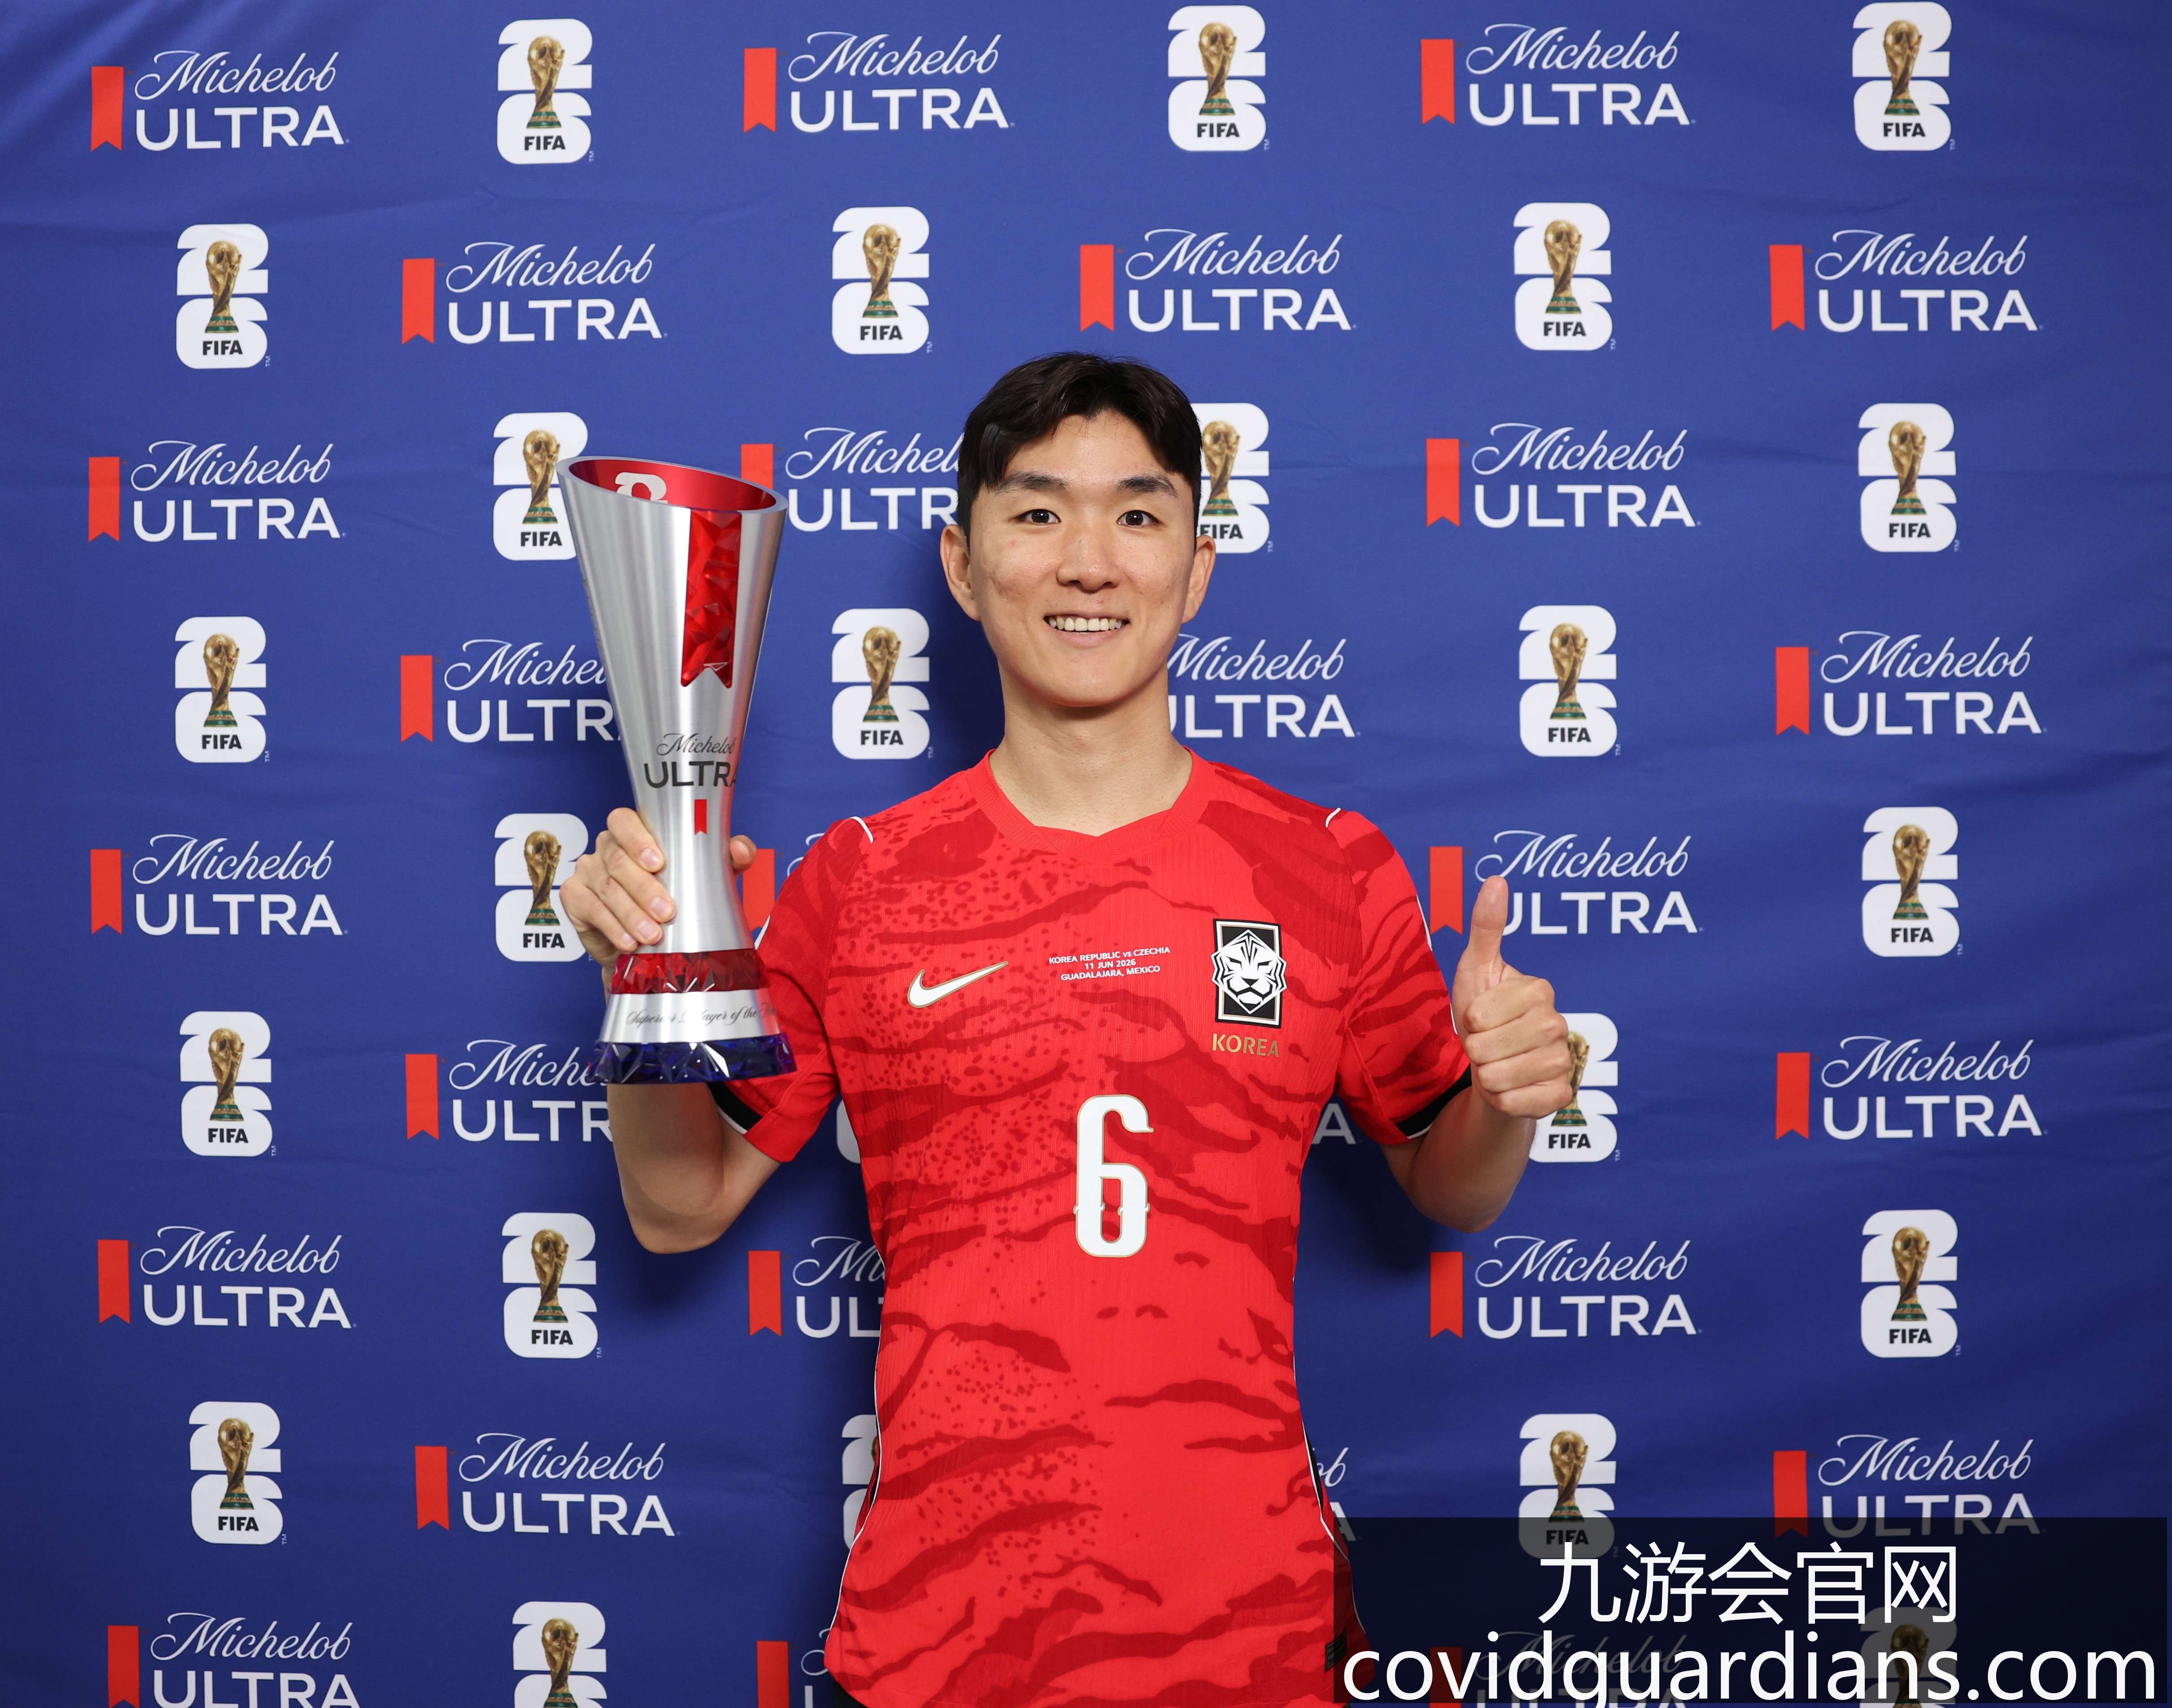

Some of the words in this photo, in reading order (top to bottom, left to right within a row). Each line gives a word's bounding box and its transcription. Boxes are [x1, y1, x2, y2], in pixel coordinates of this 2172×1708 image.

[788, 31, 1001, 82] Michelob
[1466, 24, 1679, 74] Michelob
[135, 50, 338, 100] Michelob
[791, 88, 1009, 133] ULTRA
[1470, 83, 1690, 126] ULTRA
[136, 105, 344, 151] ULTRA
[525, 136, 565, 150] FIFA
[1198, 124, 1239, 137] FIFA
[1884, 123, 1925, 136] FIFA
[446, 242, 655, 292] Michelob
[1125, 229, 1342, 280] Michelob
[1815, 230, 2027, 280] Michelob
[449, 298, 662, 344] ULTRA
[1129, 288, 1351, 332] ULTRA
[1544, 322, 1585, 336] FIFA
[1819, 289, 2037, 332] ULTRA
[203, 341, 242, 355] FIFA
[861, 326, 902, 340] FIFA
[131, 440, 333, 491] Michelob
[785, 427, 964, 479] Michel
[1472, 423, 1687, 475] Michelob
[134, 497, 340, 542] ULTRA
[789, 487, 959, 532] ULTR
[1475, 484, 1696, 528] ULTRA
[521, 532, 562, 546] FIFA
[1200, 525, 1242, 539] FIFA
[1890, 523, 1930, 537] FIFA
[445, 639, 606, 691] Miche
[1821, 631, 2032, 683] Michelob
[448, 700, 621, 743] ULTR
[1549, 728, 1590, 741] FIFA
[1824, 692, 2041, 736] ULTRA
[202, 735, 241, 749] FIFA
[861, 731, 903, 745] FIFA
[133, 834, 334, 884] Michelob
[1475, 830, 1691, 882] Michelob
[136, 894, 343, 935] ULTRA
[1892, 928, 1933, 942] FIFA
[523, 933, 564, 948] FIFA
[1080, 951, 1121, 961] REPUBLIC
[1134, 947, 1170, 956] CZECHIA
[1061, 969, 1124, 980] GUADALAJARA,
[1126, 965, 1160, 975] MEXICO
[1097, 961, 1113, 969] JUN
[1116, 959, 1136, 967] 2026
[449, 1039, 607, 1090] Mich
[1212, 1033, 1279, 1058] KOREA
[1822, 1036, 2033, 1087] Michelob
[209, 1128, 248, 1143] FIFA
[453, 1099, 613, 1142] ULTR
[1824, 1094, 2041, 1140] ULTRA
[1549, 1134, 1591, 1148] FIFA
[1073, 1094, 1153, 1257] 6
[140, 1226, 341, 1275] Michelob
[1476, 1236, 1690, 1287] Michelob
[144, 1285, 351, 1328] ULTRA
[1479, 1294, 1696, 1339] ULTRA
[532, 1330, 573, 1344] FIFA
[1890, 1329, 1932, 1343] FIFA
[459, 1433, 665, 1481] Michelob
[1819, 1435, 2033, 1486] Michelob
[218, 1516, 258, 1531] FIFA
[462, 1491, 675, 1536] ULTRA
[1822, 1493, 2041, 1538] ULTRA
[1547, 1530, 1588, 1544] FIFA
[151, 1612, 352, 1660] Michelob
[154, 1670, 360, 1708] ULTRA
